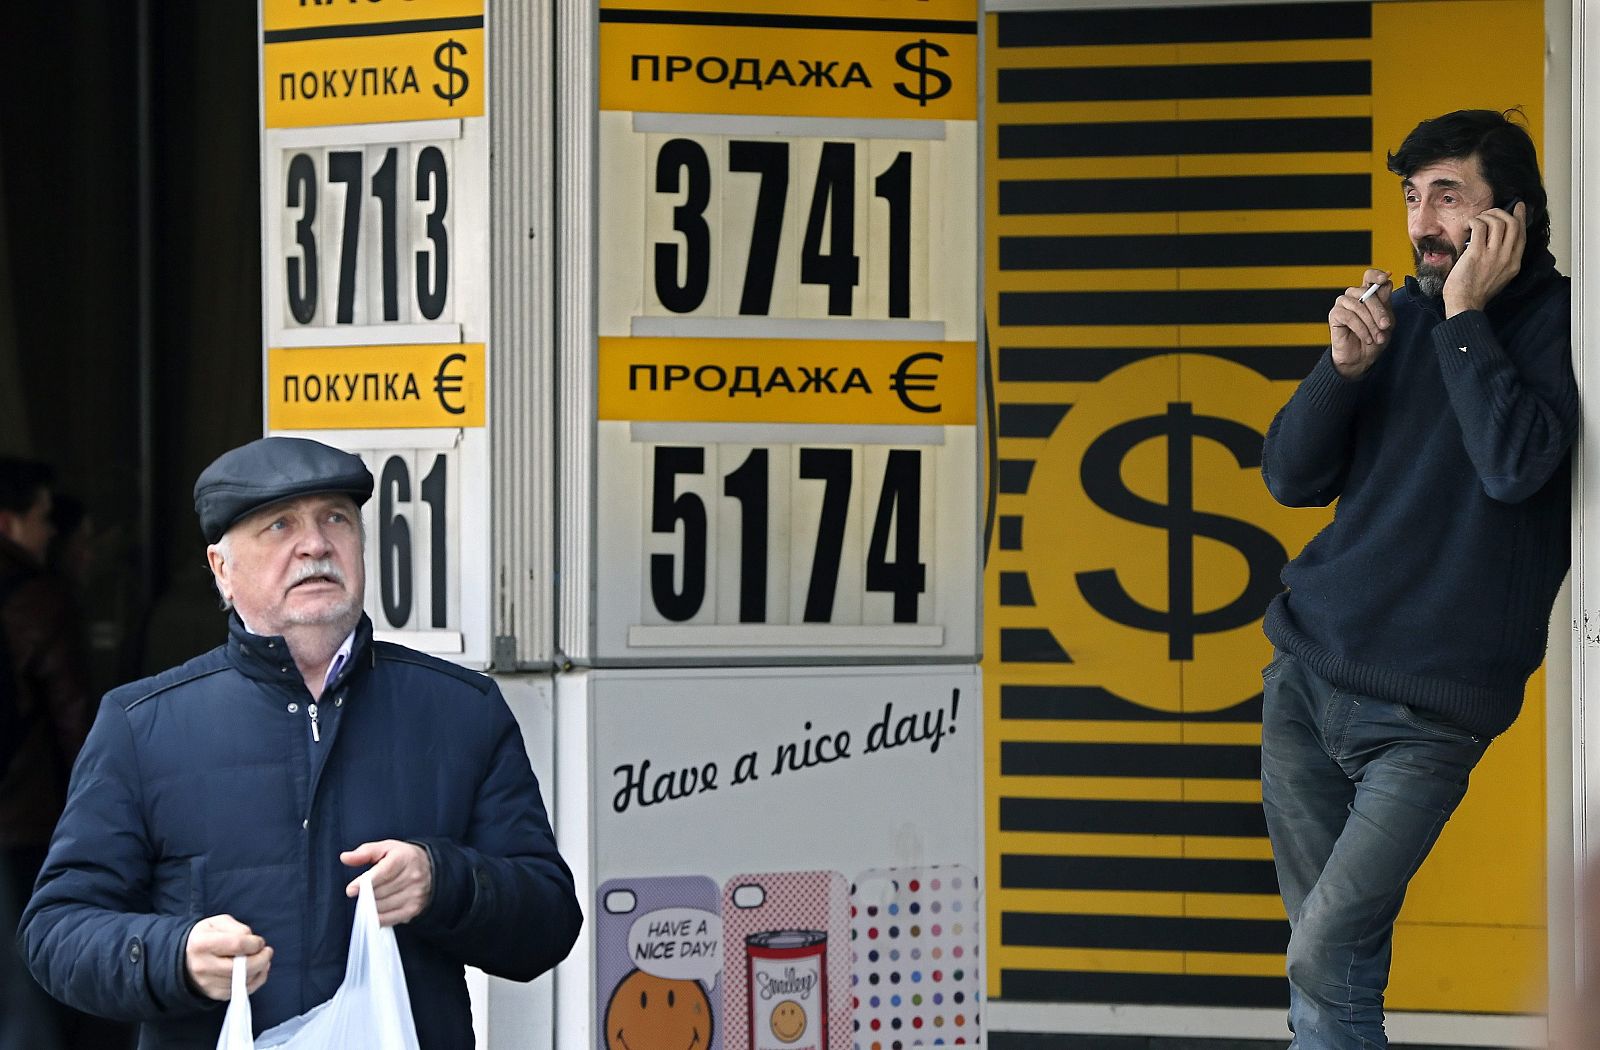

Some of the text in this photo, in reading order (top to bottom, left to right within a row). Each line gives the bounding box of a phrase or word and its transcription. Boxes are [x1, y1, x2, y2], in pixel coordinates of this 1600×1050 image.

[280, 38, 469, 107] ПОКУПКА $
[631, 38, 952, 107] ПРОДАЖА $
[286, 146, 448, 325] 3713
[654, 138, 912, 318] 3741
[284, 353, 466, 414] ПОКУПКА €
[629, 352, 944, 413] ПРОДАЖА €
[651, 446, 926, 623] 5174
[613, 688, 961, 813] Have a nice day!
[634, 940, 718, 960] NICE DAY!
[647, 920, 708, 937] HAVE A
